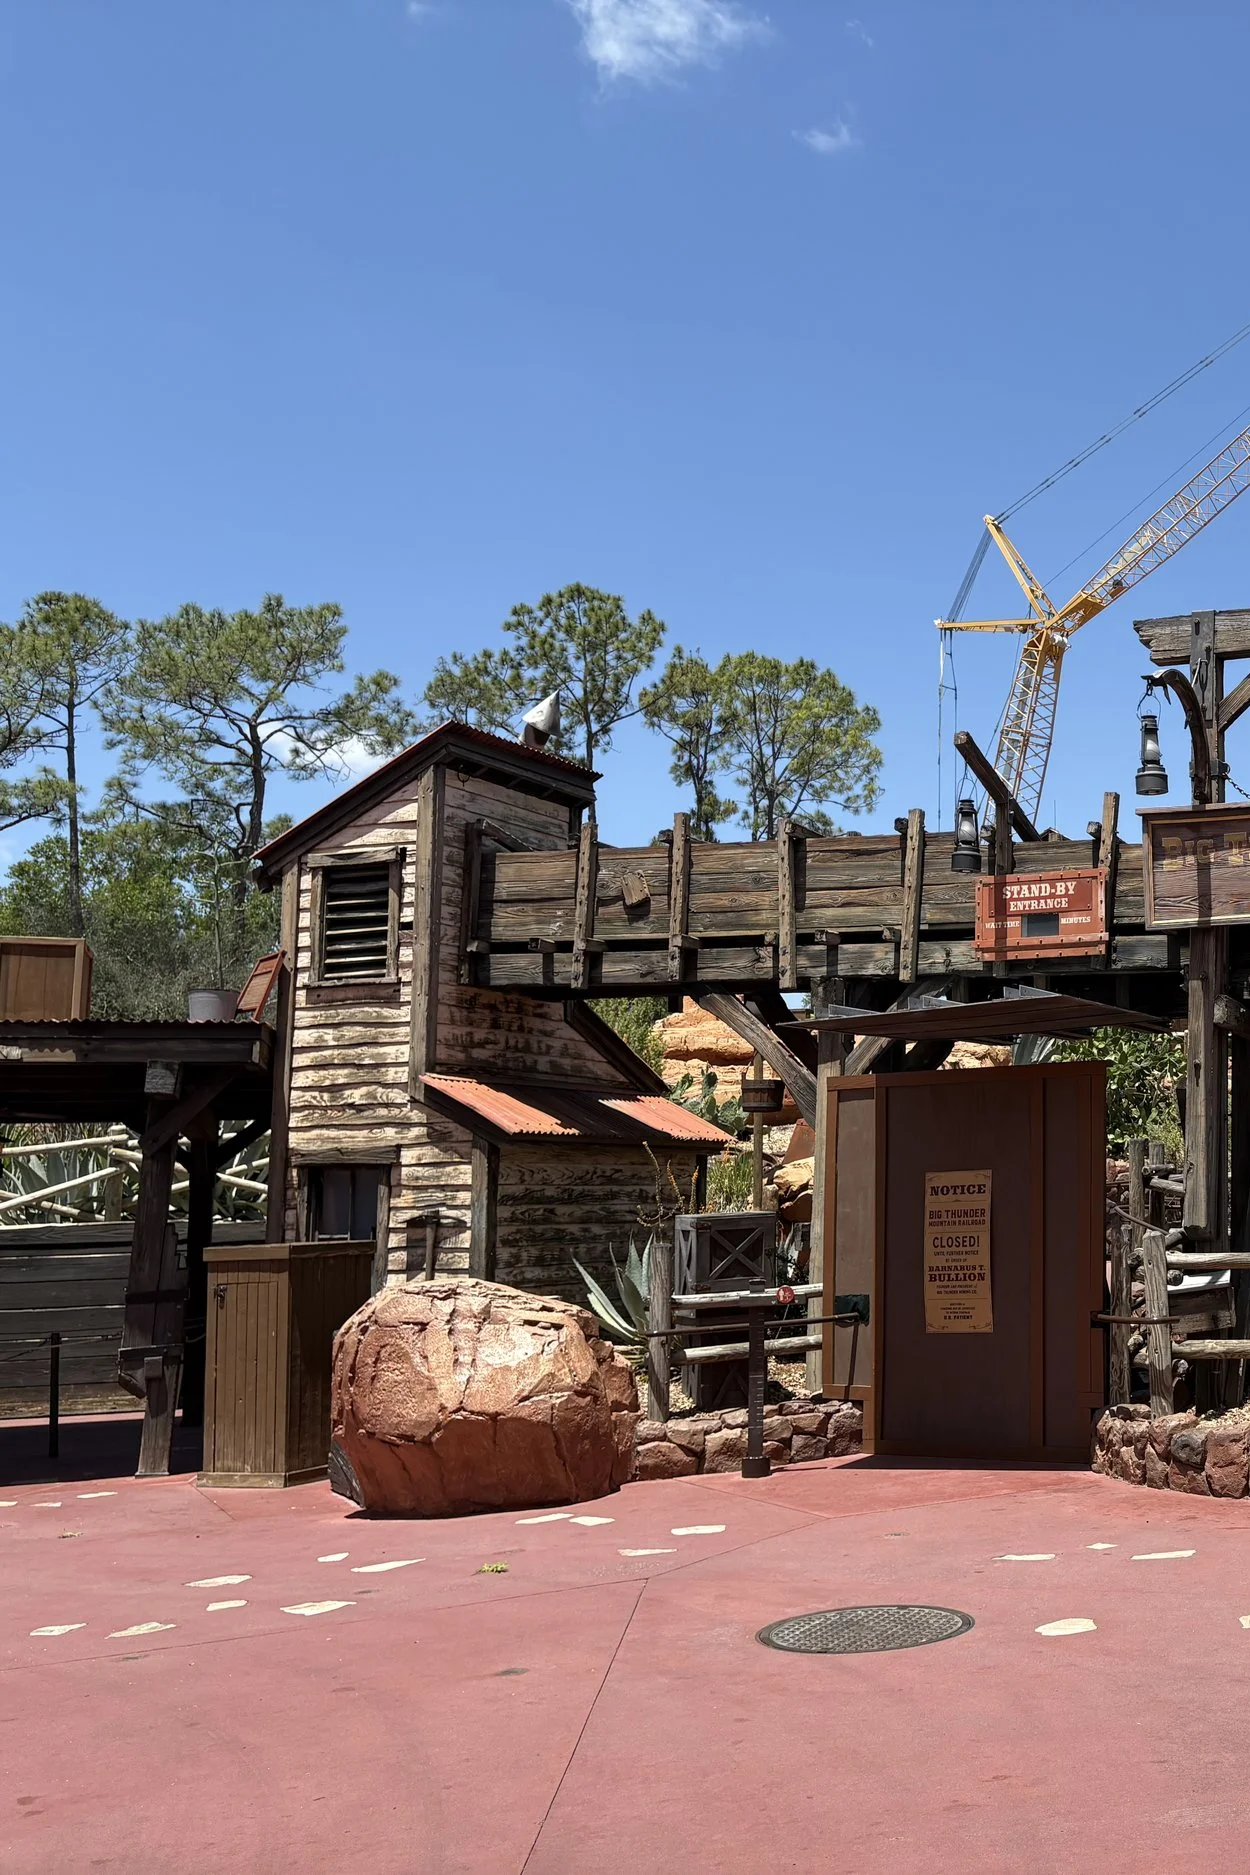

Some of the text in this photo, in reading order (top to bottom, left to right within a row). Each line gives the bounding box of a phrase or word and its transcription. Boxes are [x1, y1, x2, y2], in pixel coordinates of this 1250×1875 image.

[1161, 836, 1215, 871] BIG
[1002, 881, 1076, 899] STAND-BY
[1009, 898, 1068, 912] ENTRANCE
[1060, 916, 1091, 925] MINUTES
[930, 1184, 986, 1196] NOTICE
[929, 1208, 986, 1219] BIG THUNDER
[933, 1236, 980, 1248] CLOSED!
[928, 1272, 986, 1282] BULLION
